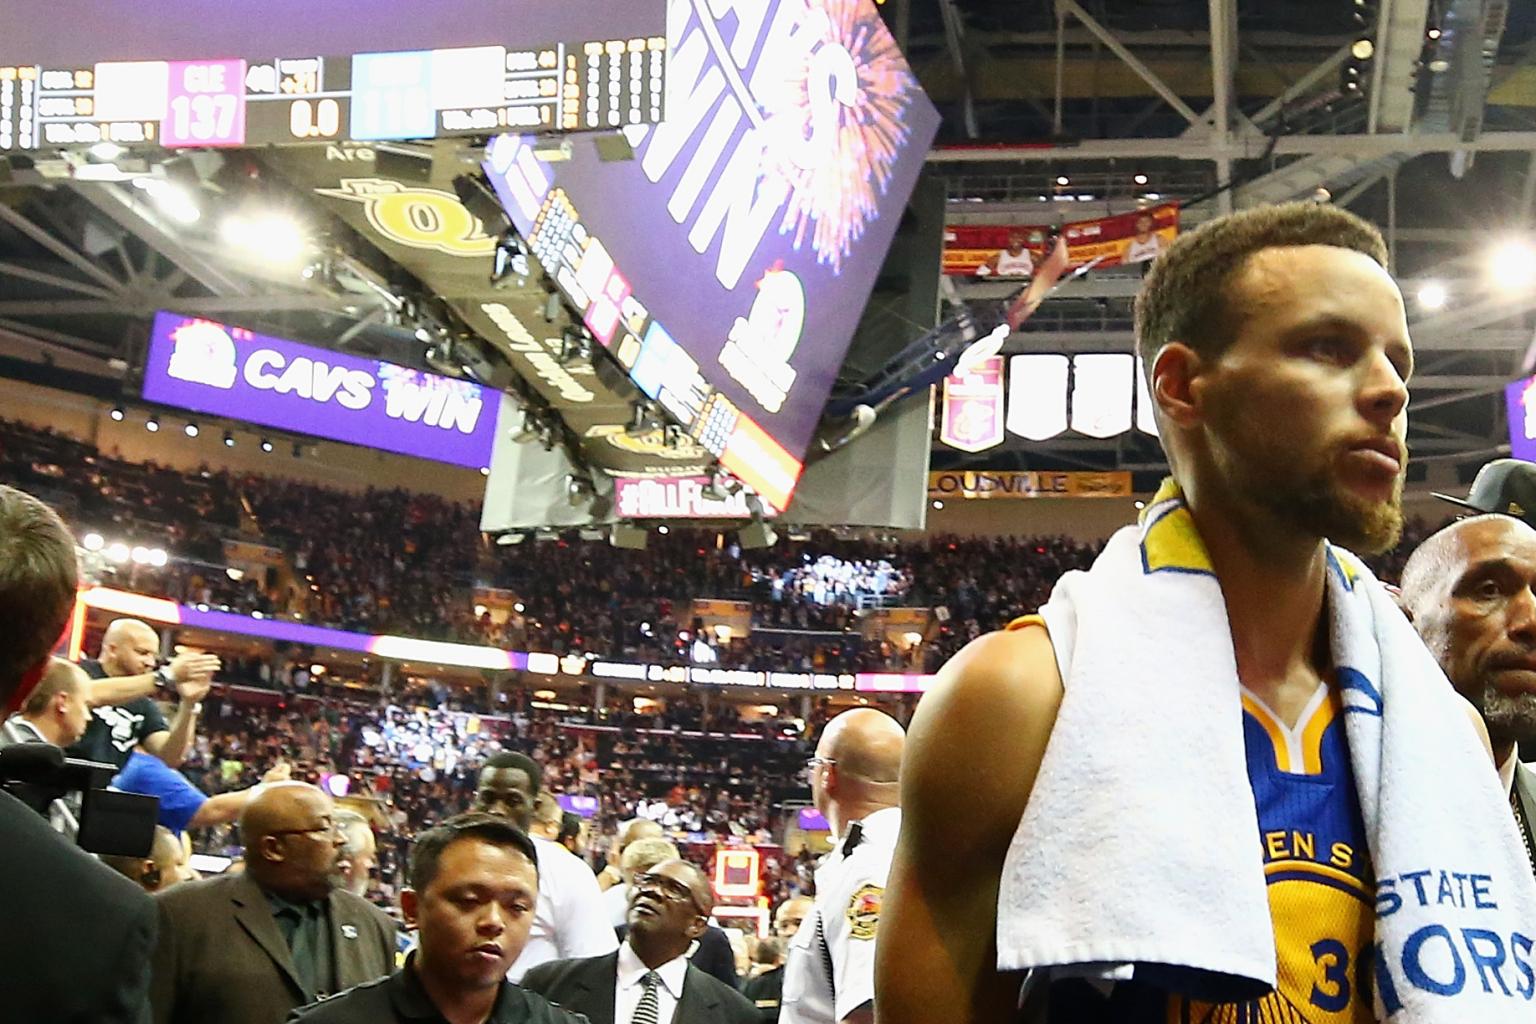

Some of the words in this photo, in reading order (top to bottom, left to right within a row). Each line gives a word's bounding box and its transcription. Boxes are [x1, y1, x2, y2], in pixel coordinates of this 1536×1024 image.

[171, 94, 238, 140] 137
[290, 98, 339, 138] 0.0
[243, 348, 376, 410] CAVS
[384, 377, 483, 434] WIN
[1375, 869, 1498, 917] STATE
